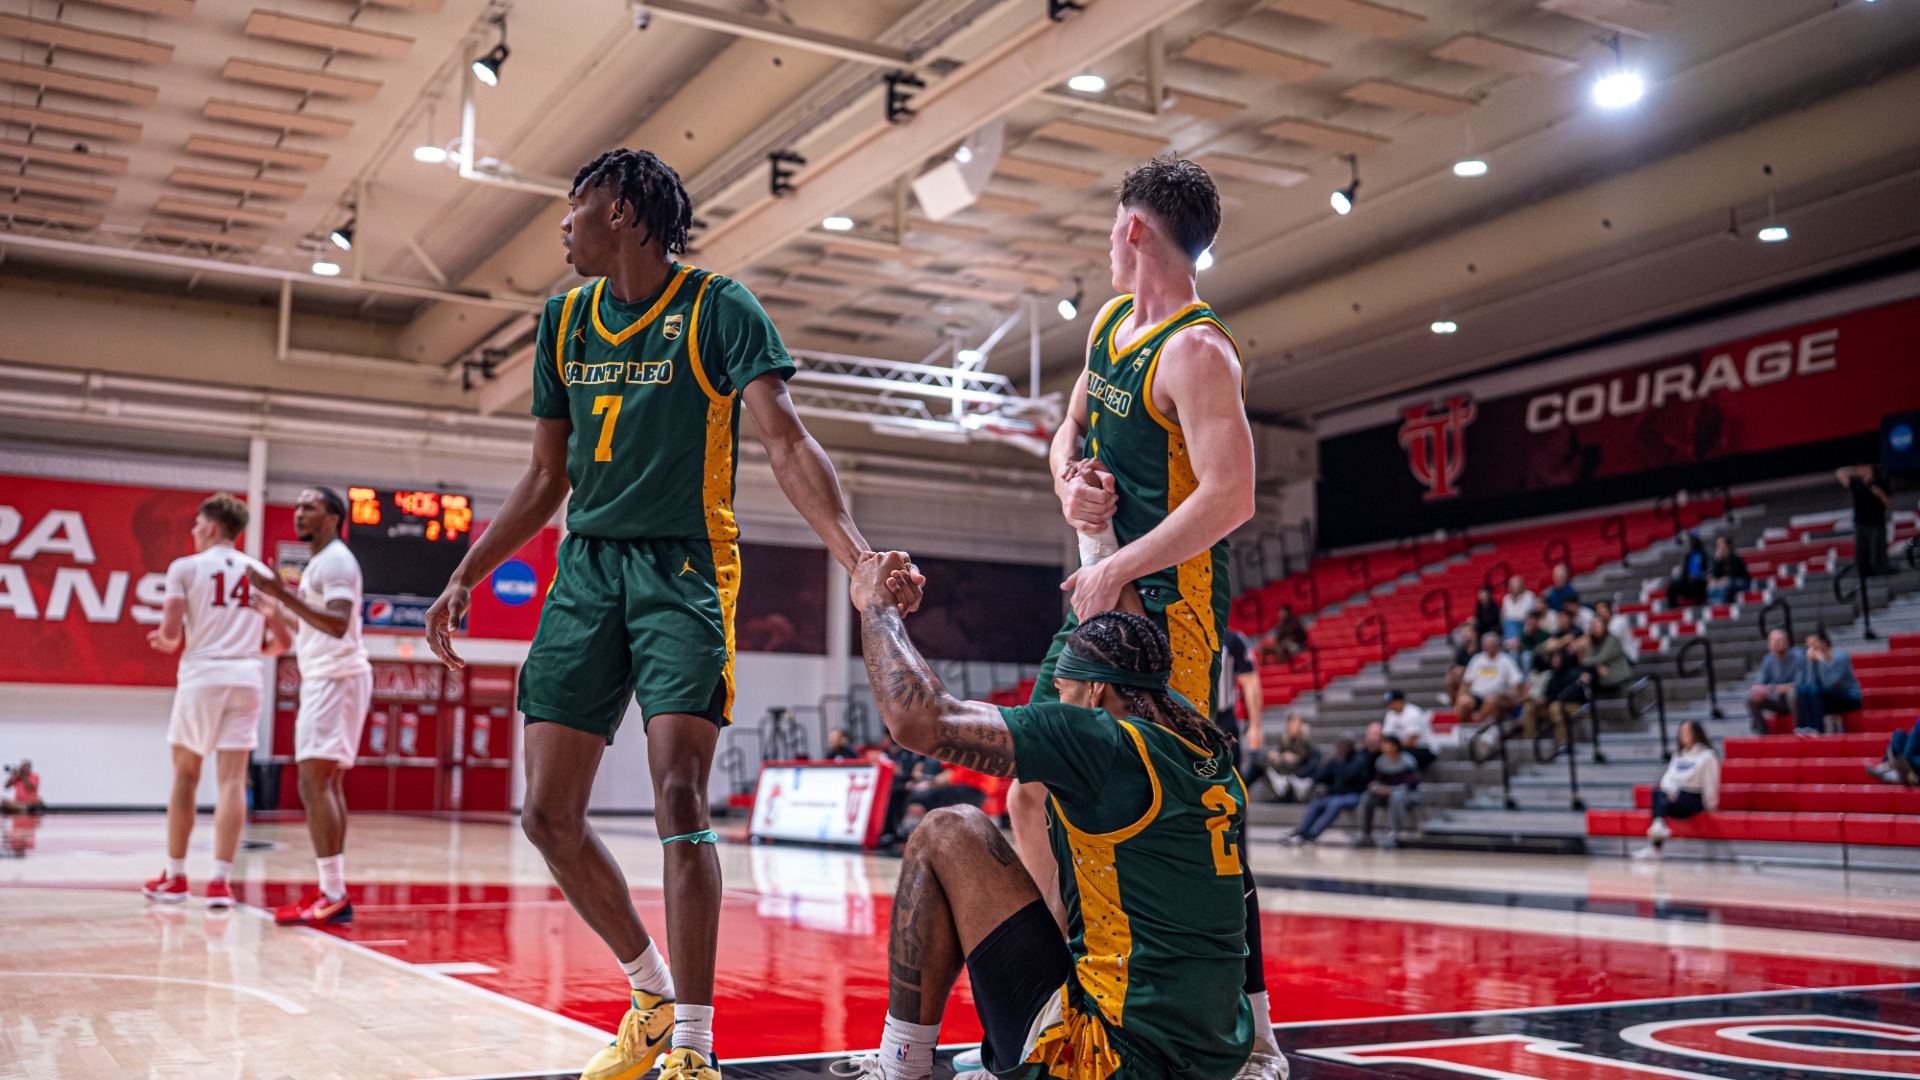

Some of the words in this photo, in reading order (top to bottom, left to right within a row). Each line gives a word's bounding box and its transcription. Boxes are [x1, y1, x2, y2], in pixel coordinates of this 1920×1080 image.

[565, 361, 624, 386] SAINT
[625, 359, 673, 385] LEO
[1526, 328, 1839, 433] COURAGE
[1104, 384, 1132, 417] LEO
[592, 395, 623, 462] 7
[211, 570, 254, 608] 14
[278, 663, 464, 701] STANS
[1201, 784, 1243, 876] 2
